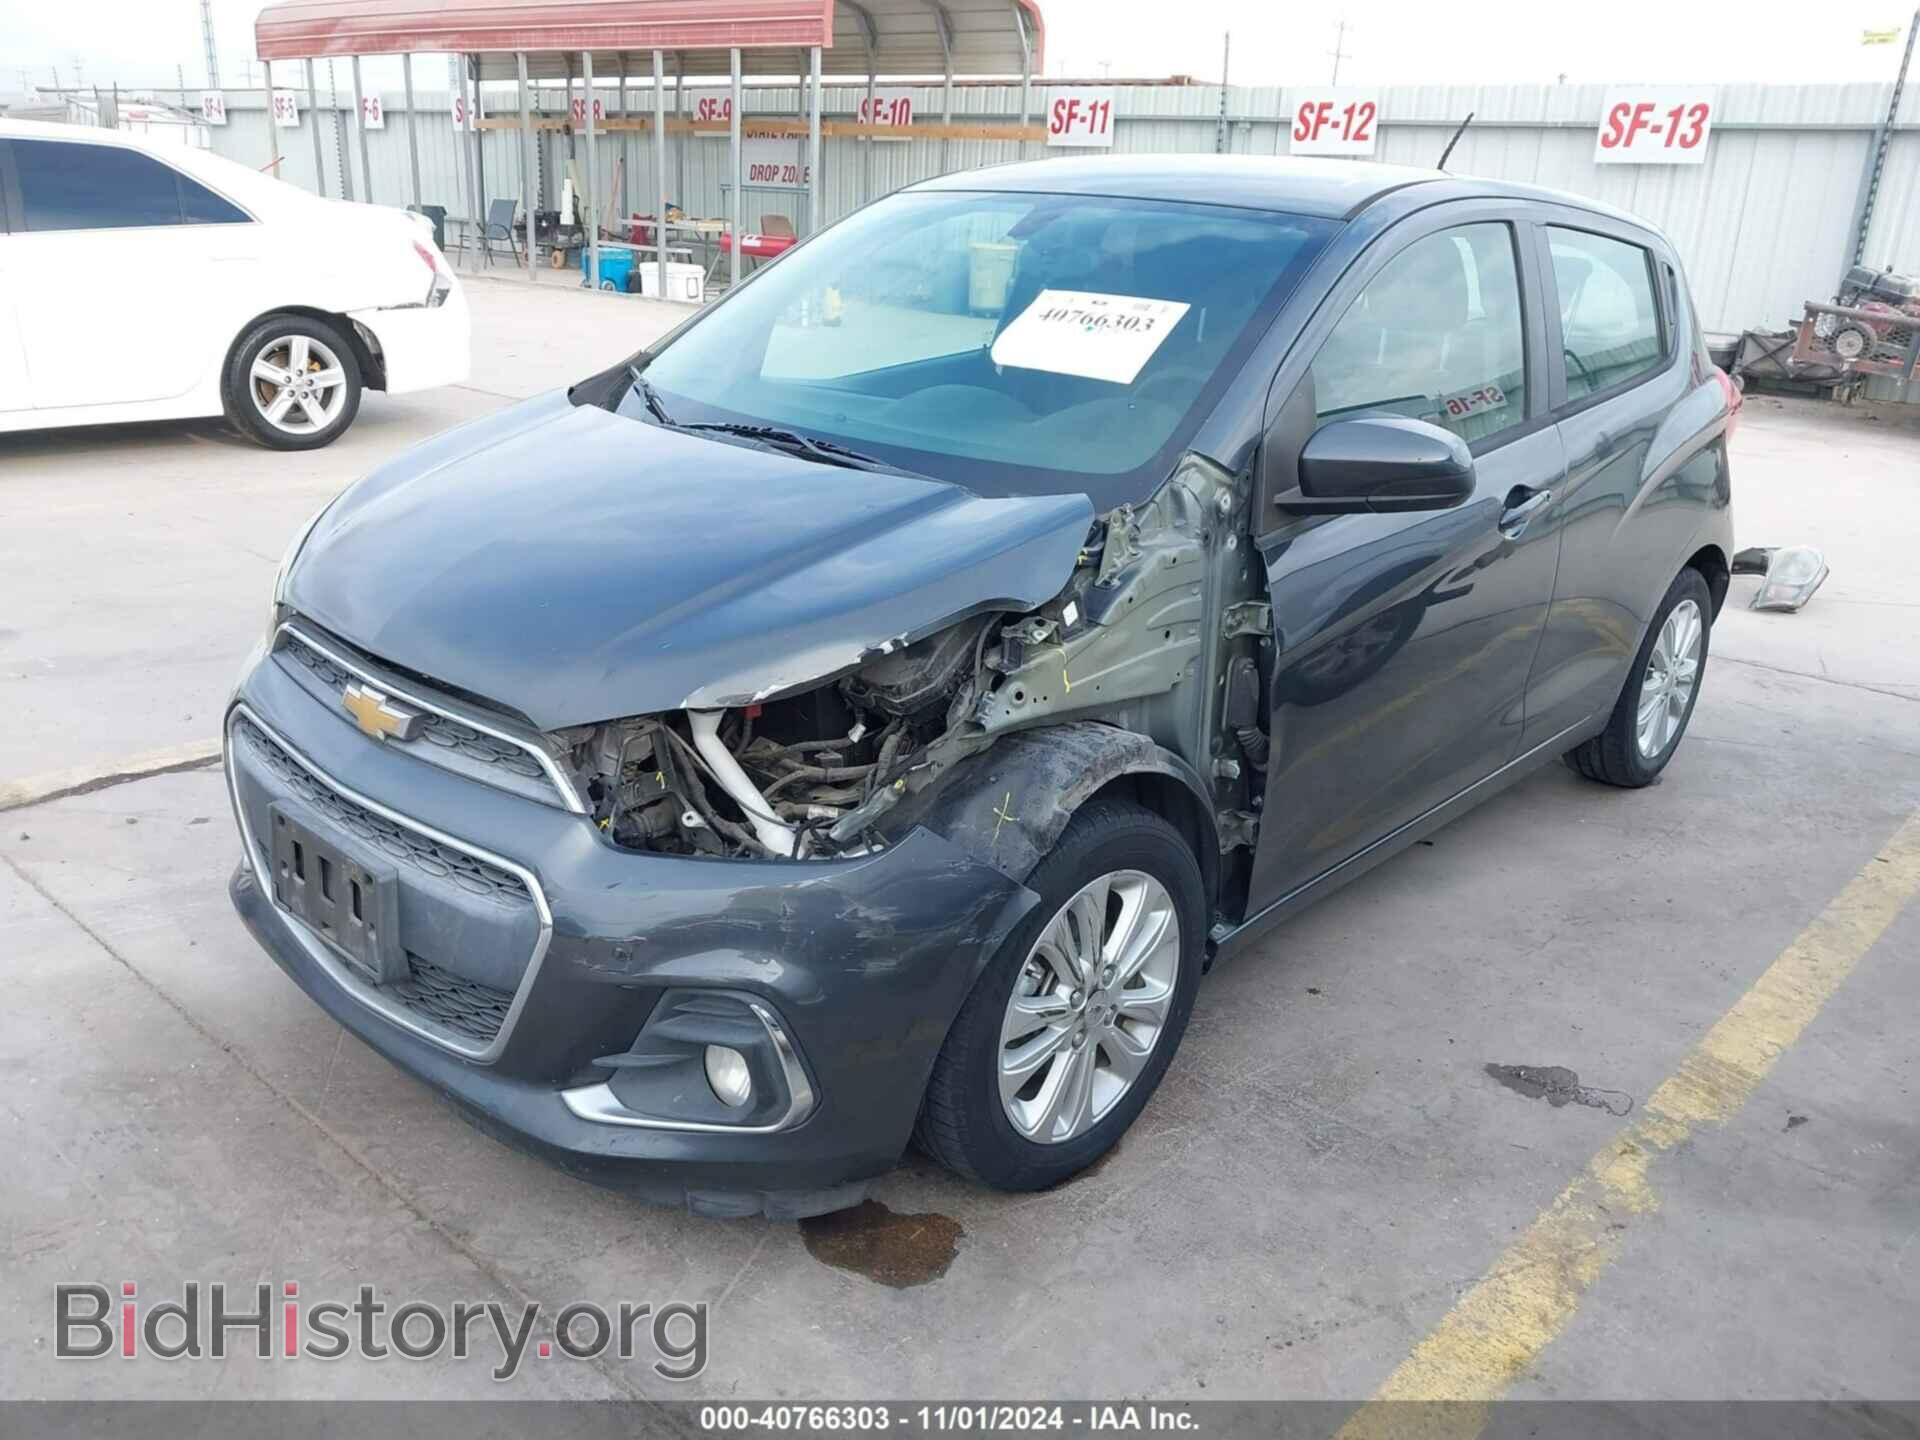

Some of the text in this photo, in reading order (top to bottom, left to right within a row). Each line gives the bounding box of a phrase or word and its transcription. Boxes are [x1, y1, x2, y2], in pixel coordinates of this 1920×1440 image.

[204, 97, 223, 118] SF-4
[275, 97, 294, 119] SF-5
[361, 97, 379, 121] F-6
[698, 98, 732, 121] SF-9
[1051, 98, 1110, 135] SF-11
[1294, 101, 1376, 142] SF-12
[1600, 102, 1710, 149] SF-13
[750, 163, 780, 182] DROP
[1039, 307, 1156, 333] 40766303
